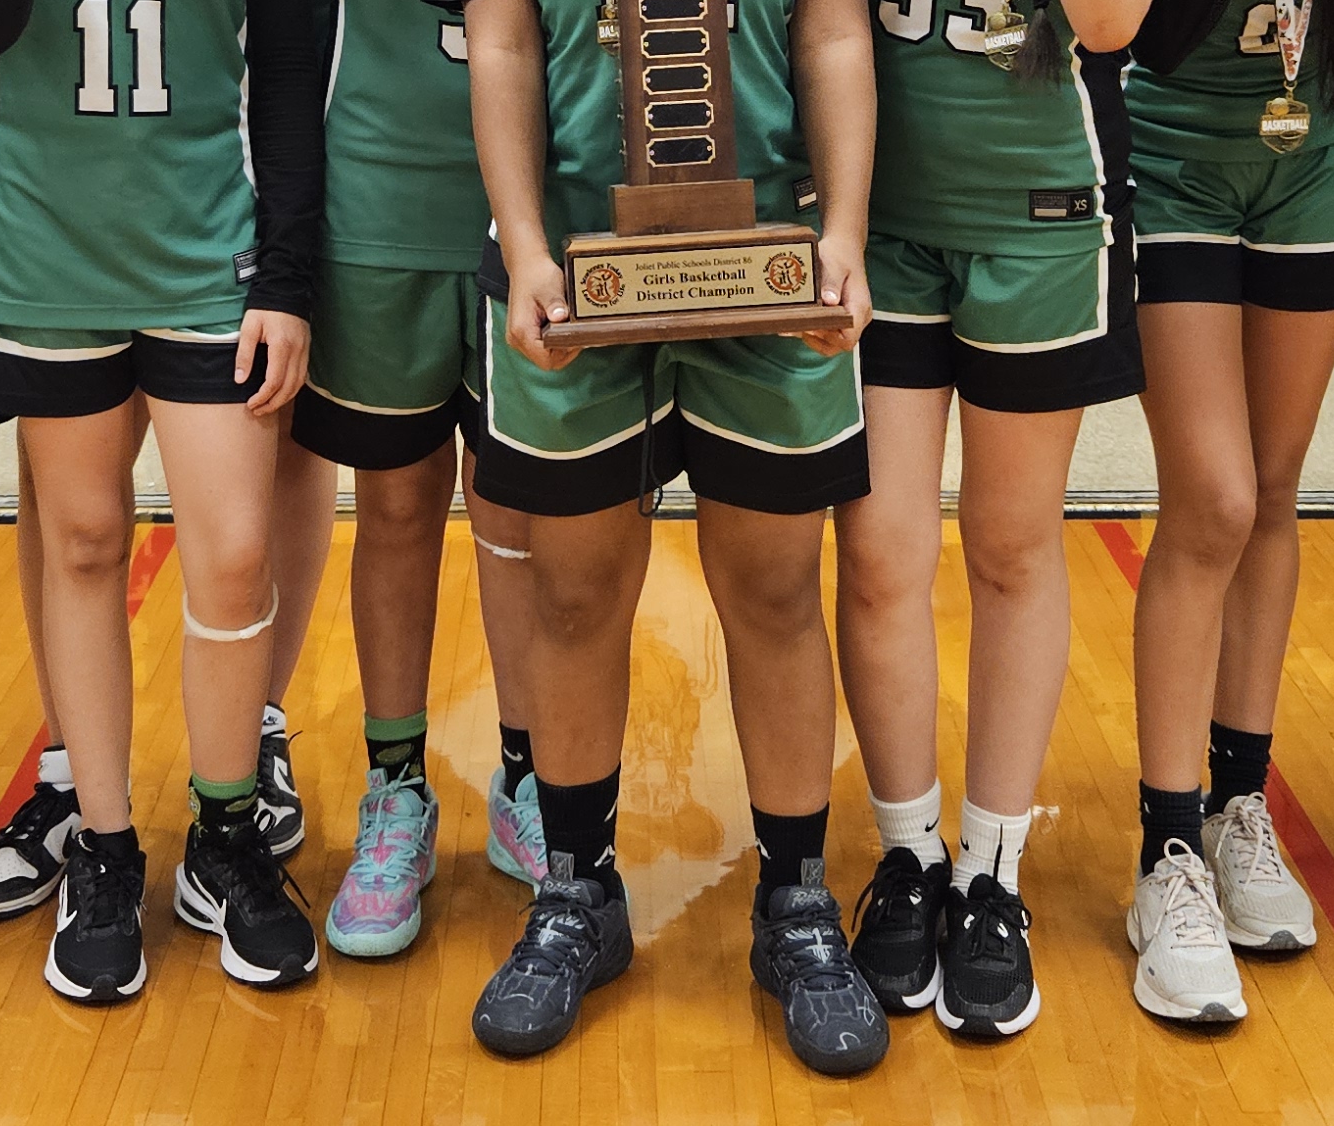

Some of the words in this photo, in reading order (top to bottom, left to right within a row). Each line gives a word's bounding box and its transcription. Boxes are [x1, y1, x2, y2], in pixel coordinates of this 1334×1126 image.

[1261, 118, 1309, 132] BASKETBALL
[1074, 199, 1088, 212] XS
[635, 263, 655, 271] Joliet
[657, 261, 680, 270] Public
[682, 258, 711, 268] Schools
[713, 257, 741, 266] District
[742, 256, 752, 265] 86
[643, 274, 675, 285] Girls
[679, 269, 746, 283] Basketball
[636, 290, 684, 302] District
[687, 285, 754, 298] Champion
